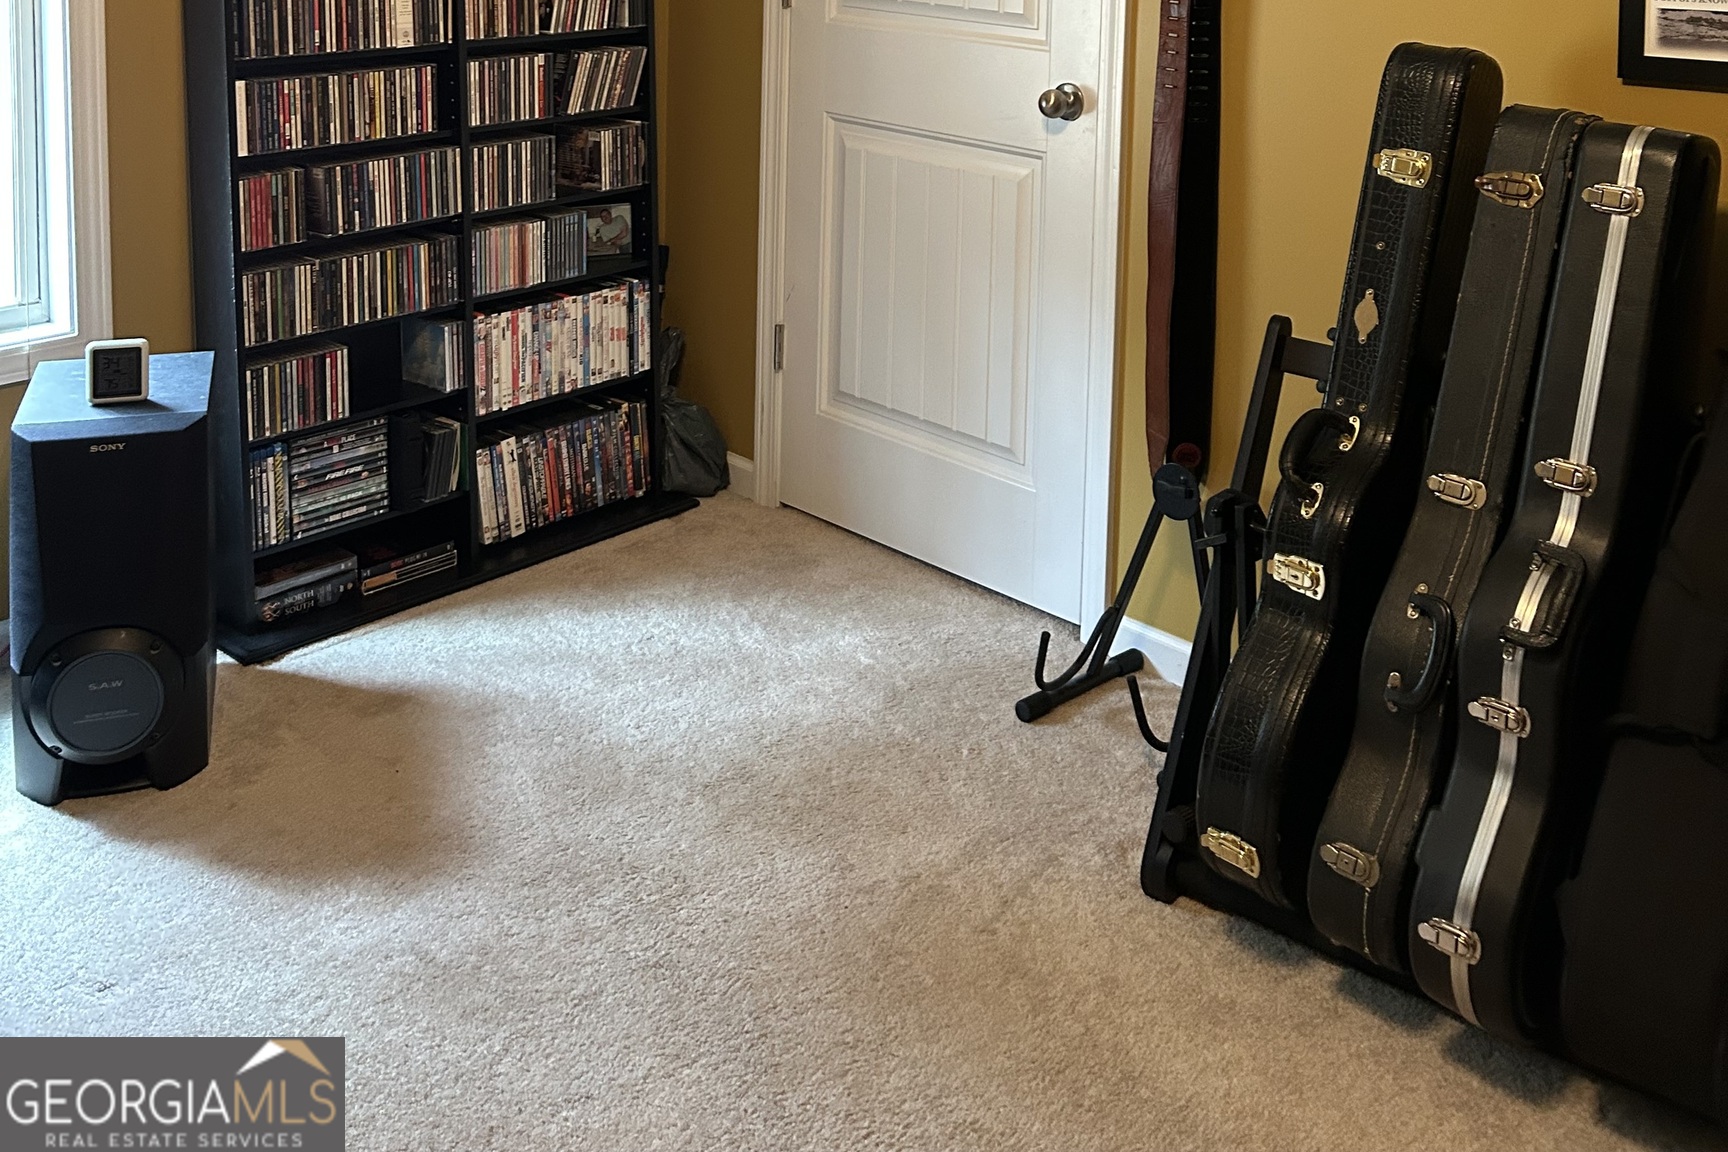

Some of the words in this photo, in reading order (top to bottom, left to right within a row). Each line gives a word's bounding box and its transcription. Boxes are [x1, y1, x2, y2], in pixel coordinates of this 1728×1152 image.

[90, 442, 126, 452] SONY
[284, 589, 314, 604] NORTH
[284, 600, 314, 616] SOUTH
